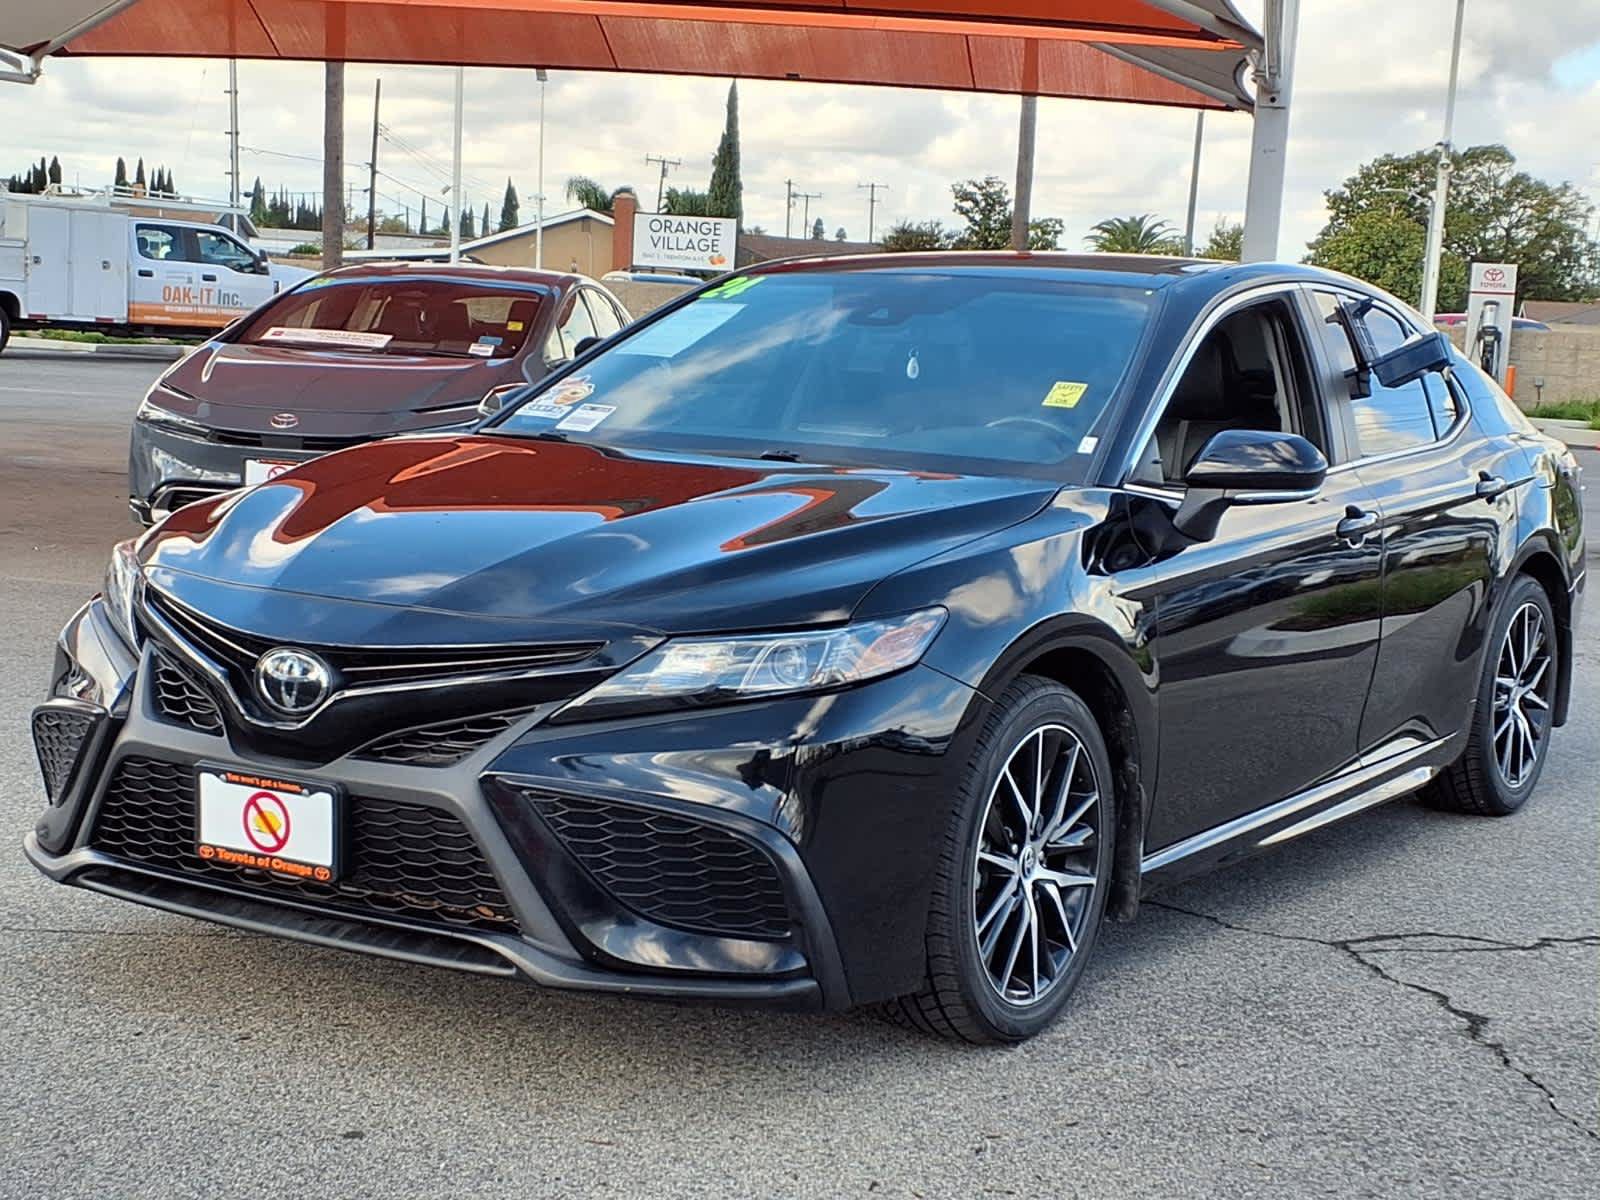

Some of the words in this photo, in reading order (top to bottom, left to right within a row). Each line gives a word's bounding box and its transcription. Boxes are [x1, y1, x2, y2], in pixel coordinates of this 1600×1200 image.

[649, 218, 722, 237] ORANGE
[650, 235, 720, 253] VILLAGE
[162, 285, 214, 304] OAK-IT
[217, 288, 242, 306] Inc.
[1056, 383, 1084, 392] SAFETY
[216, 847, 256, 866] Toyota
[257, 856, 272, 868] of
[271, 857, 313, 877] Orange
